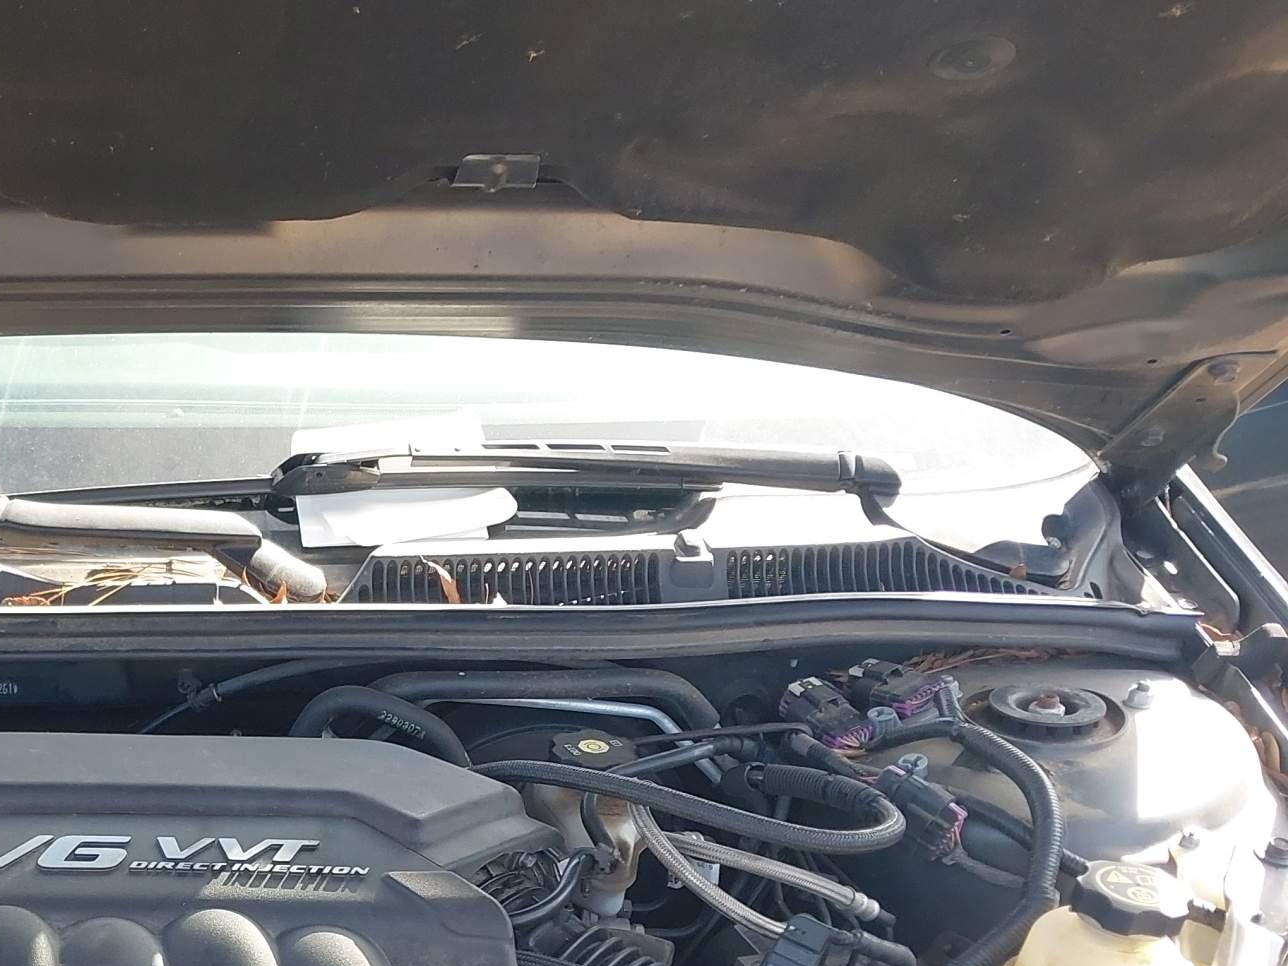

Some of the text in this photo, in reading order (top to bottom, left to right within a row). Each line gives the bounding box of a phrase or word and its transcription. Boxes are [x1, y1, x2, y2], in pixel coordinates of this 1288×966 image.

[155, 836, 321, 862] VVT
[129, 860, 370, 876] DIRECT INJECTION
